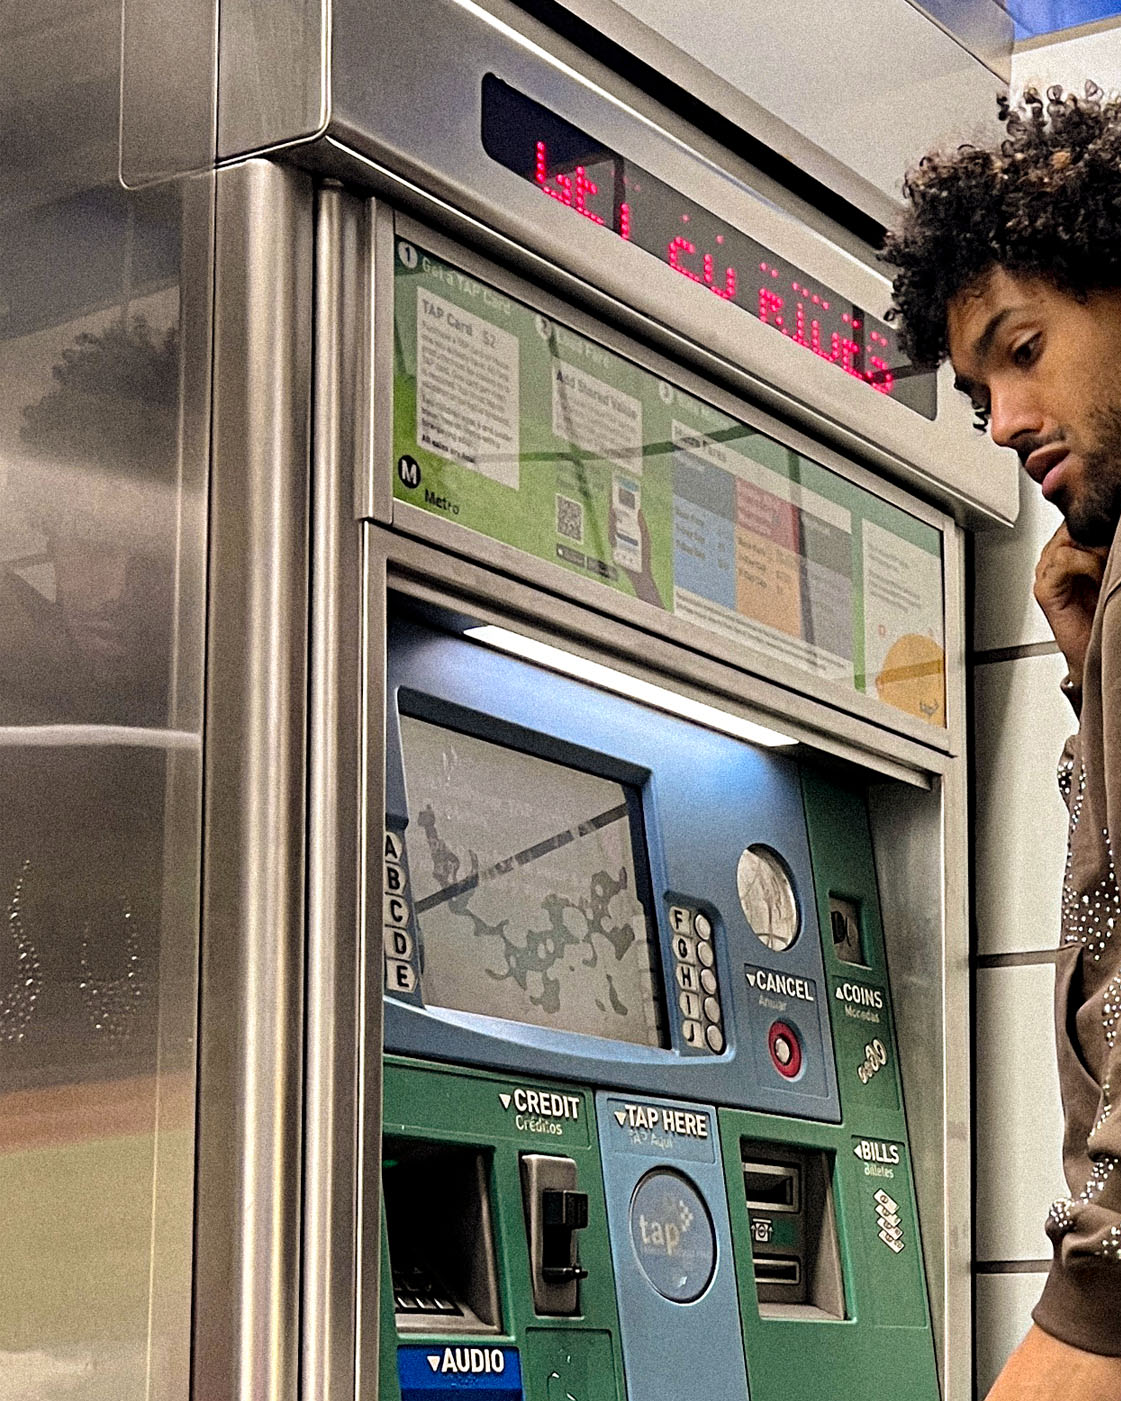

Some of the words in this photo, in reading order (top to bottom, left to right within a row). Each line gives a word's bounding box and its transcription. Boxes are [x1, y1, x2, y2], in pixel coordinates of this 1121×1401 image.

[422, 299, 445, 319] TAP
[447, 313, 473, 337] Card
[401, 458, 417, 486] M
[425, 488, 460, 515] Metro
[385, 834, 397, 859] A
[387, 867, 400, 890] B
[390, 899, 403, 922] C
[673, 909, 683, 930] F
[394, 931, 406, 954] D
[396, 965, 410, 988] E
[681, 966, 691, 987] H
[756, 970, 815, 1002] CANCEL
[842, 983, 883, 1009] COINS
[687, 1023, 694, 1043] J
[513, 1088, 580, 1119] CREDIT
[624, 1104, 659, 1129] TAP
[662, 1109, 708, 1137] HERE
[861, 1140, 900, 1164] BILLS
[640, 1214, 680, 1256] tap
[441, 1347, 504, 1373] AUDIO
